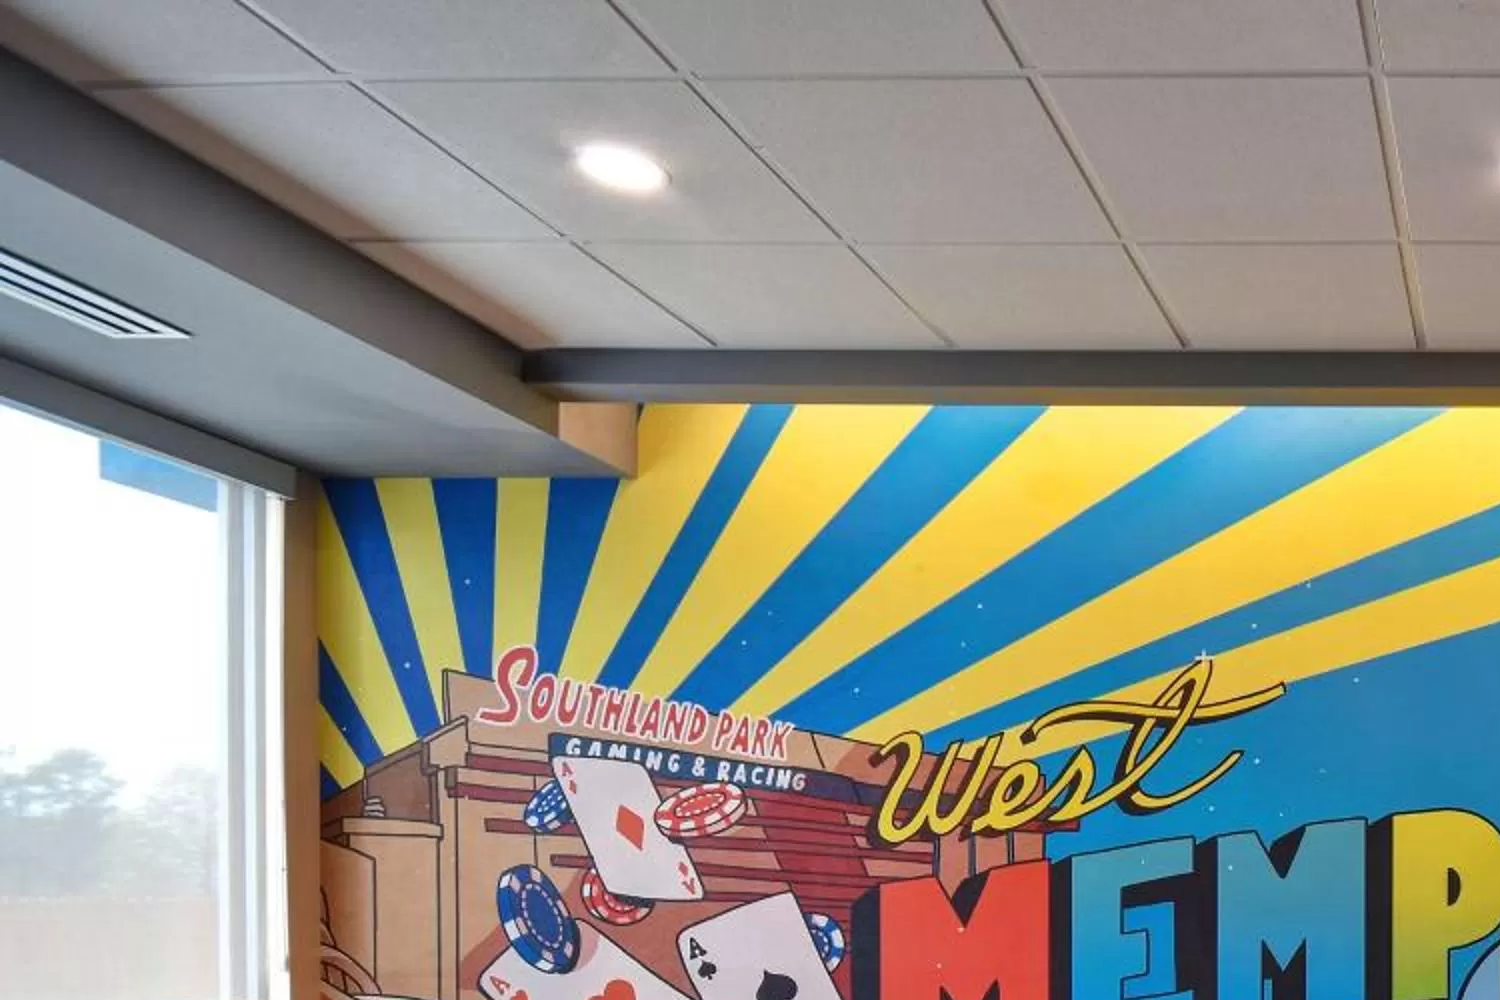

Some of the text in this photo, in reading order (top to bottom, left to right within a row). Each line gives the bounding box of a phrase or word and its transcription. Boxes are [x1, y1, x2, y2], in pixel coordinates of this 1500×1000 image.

[476, 643, 798, 761] SOUTHLAND PARK
[566, 737, 807, 789] GAMING & RACING
[868, 657, 1288, 846] West
[688, 937, 707, 960] A
